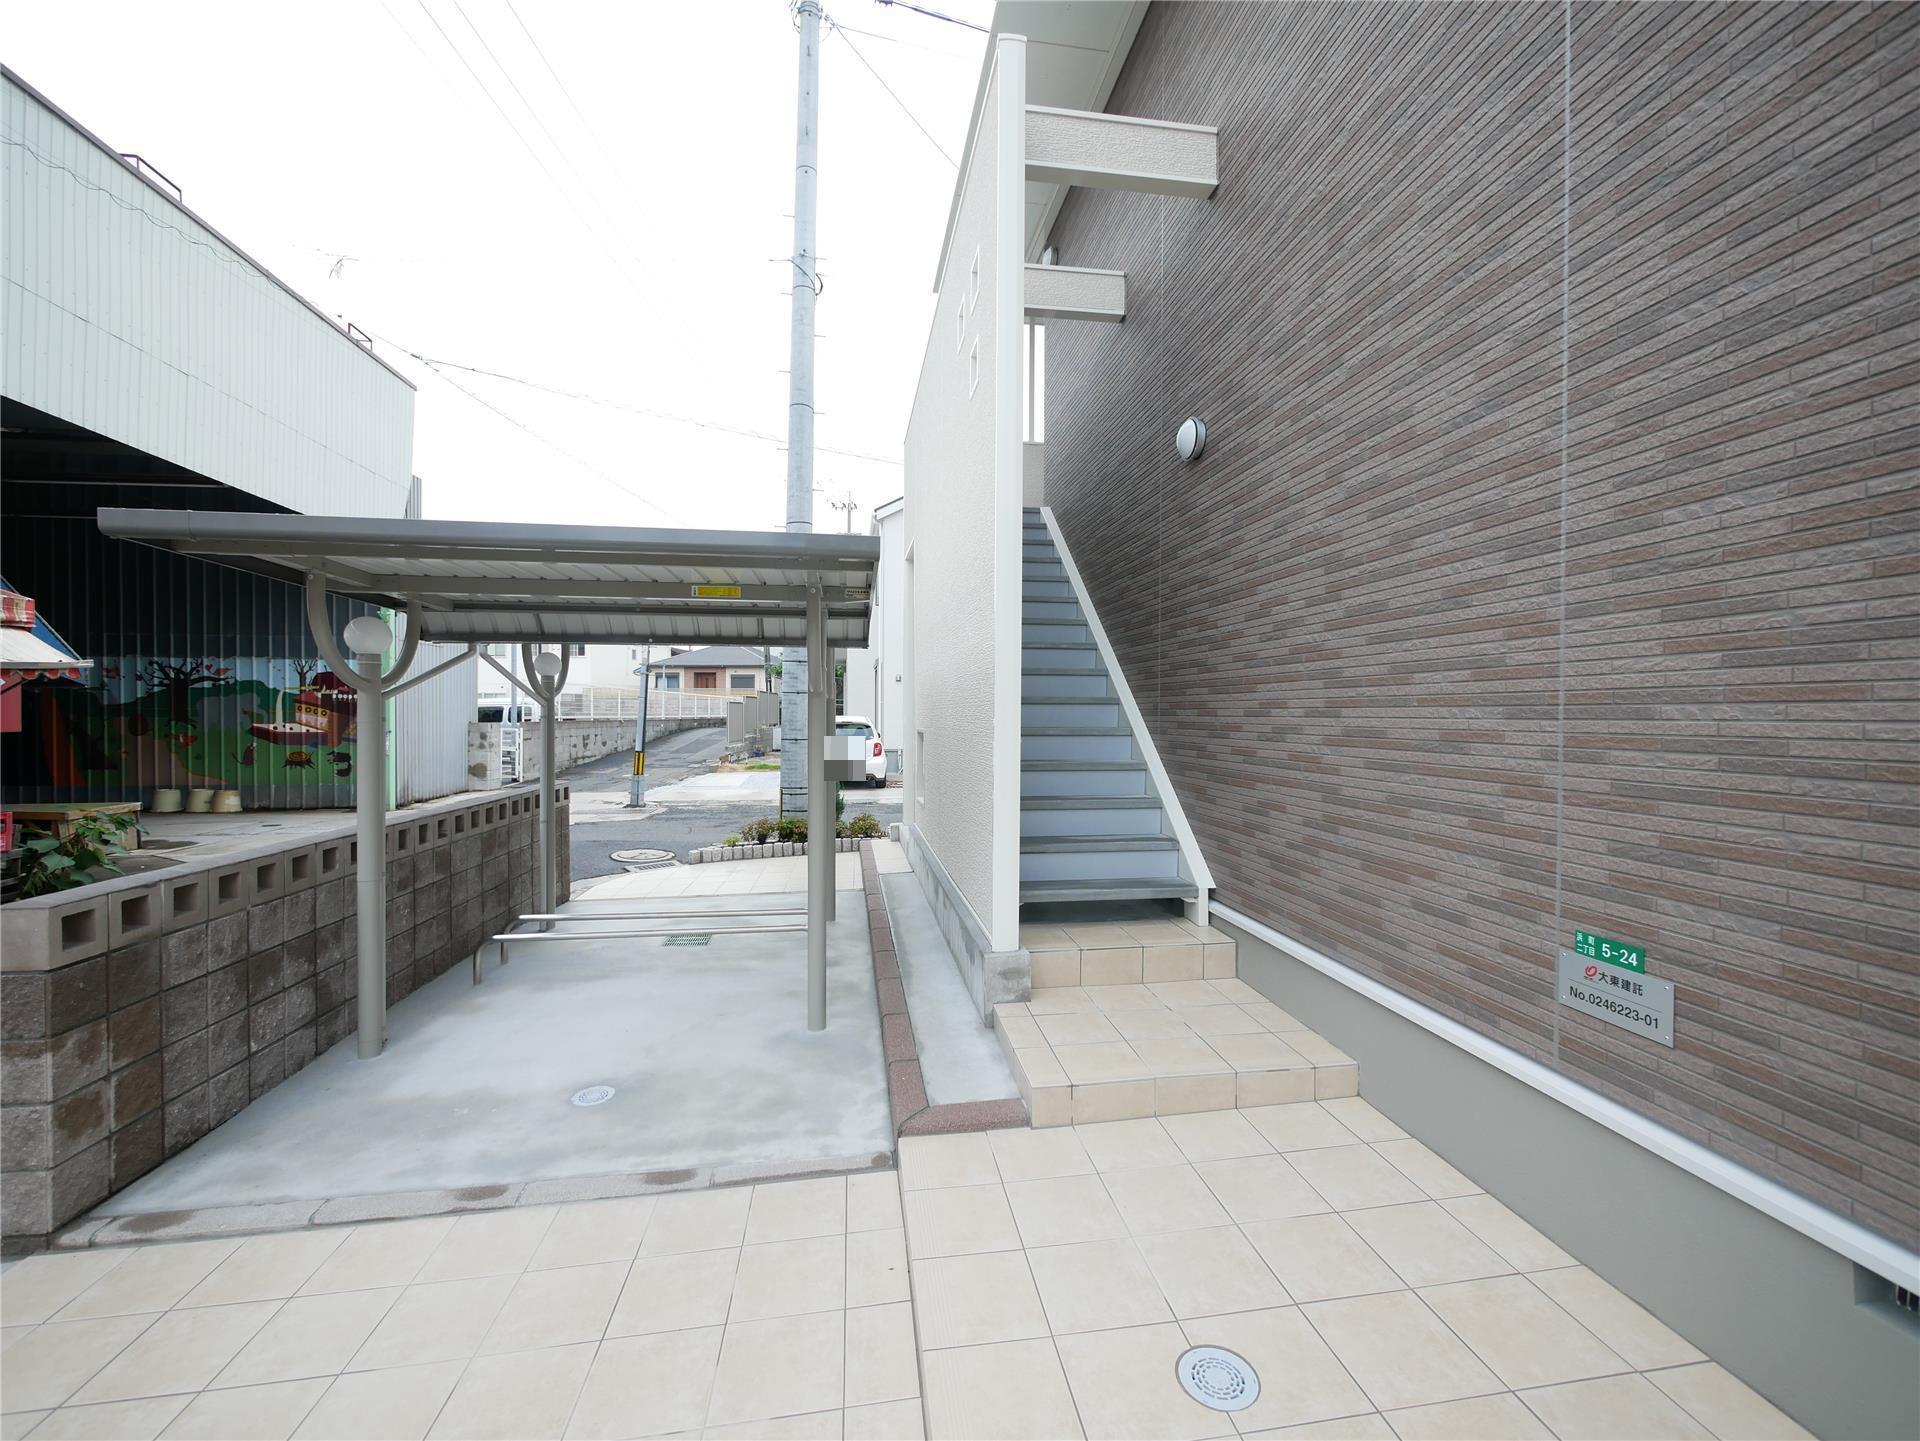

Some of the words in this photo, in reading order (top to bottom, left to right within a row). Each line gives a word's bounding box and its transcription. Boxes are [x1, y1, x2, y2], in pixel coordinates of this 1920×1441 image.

[1577, 943, 1596, 957] 二丁目
[1601, 943, 1638, 967] 5-24
[1598, 971, 1643, 996] 大東建託
[1569, 986, 1659, 1029] No.0246223-01
